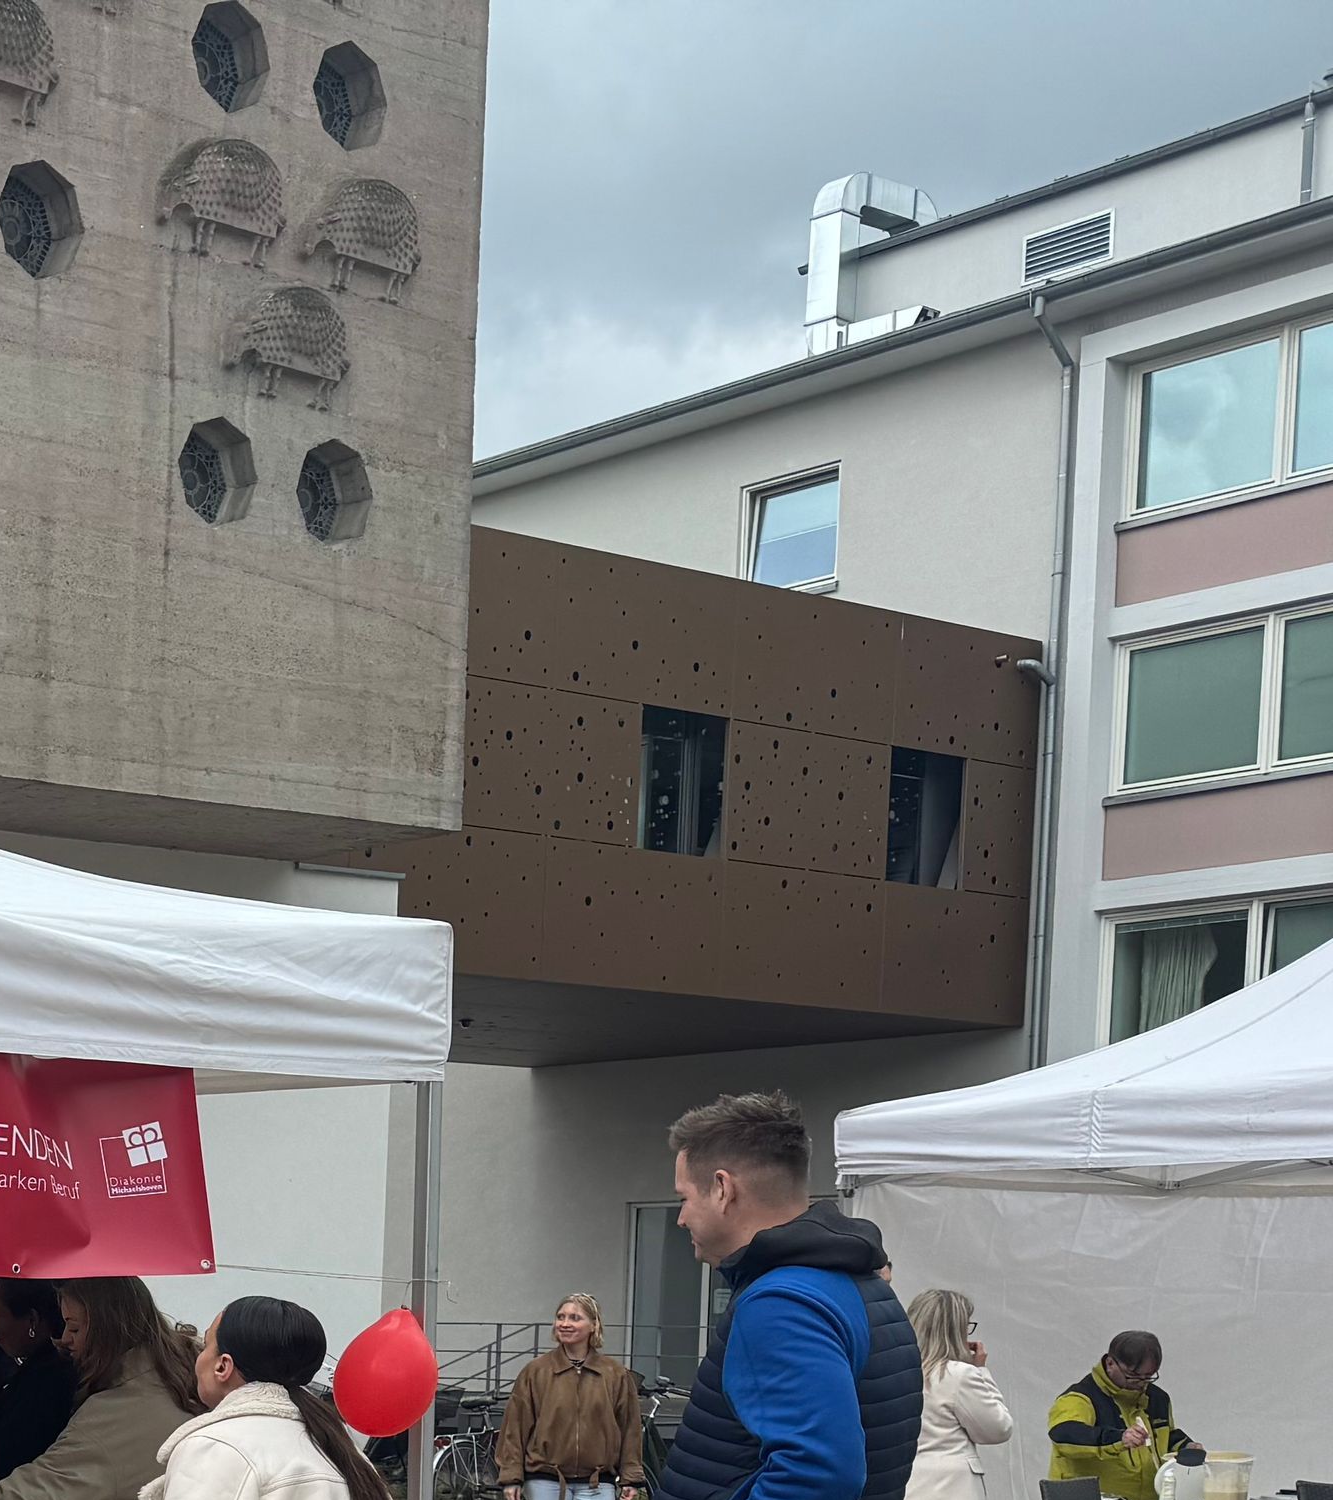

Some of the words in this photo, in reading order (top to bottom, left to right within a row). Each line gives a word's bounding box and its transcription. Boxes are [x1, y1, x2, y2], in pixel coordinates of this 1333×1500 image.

[50, 1174, 81, 1200] Beruf
[109, 1175, 162, 1187] Diakonie
[110, 1184, 163, 1195] Michaelshoven
